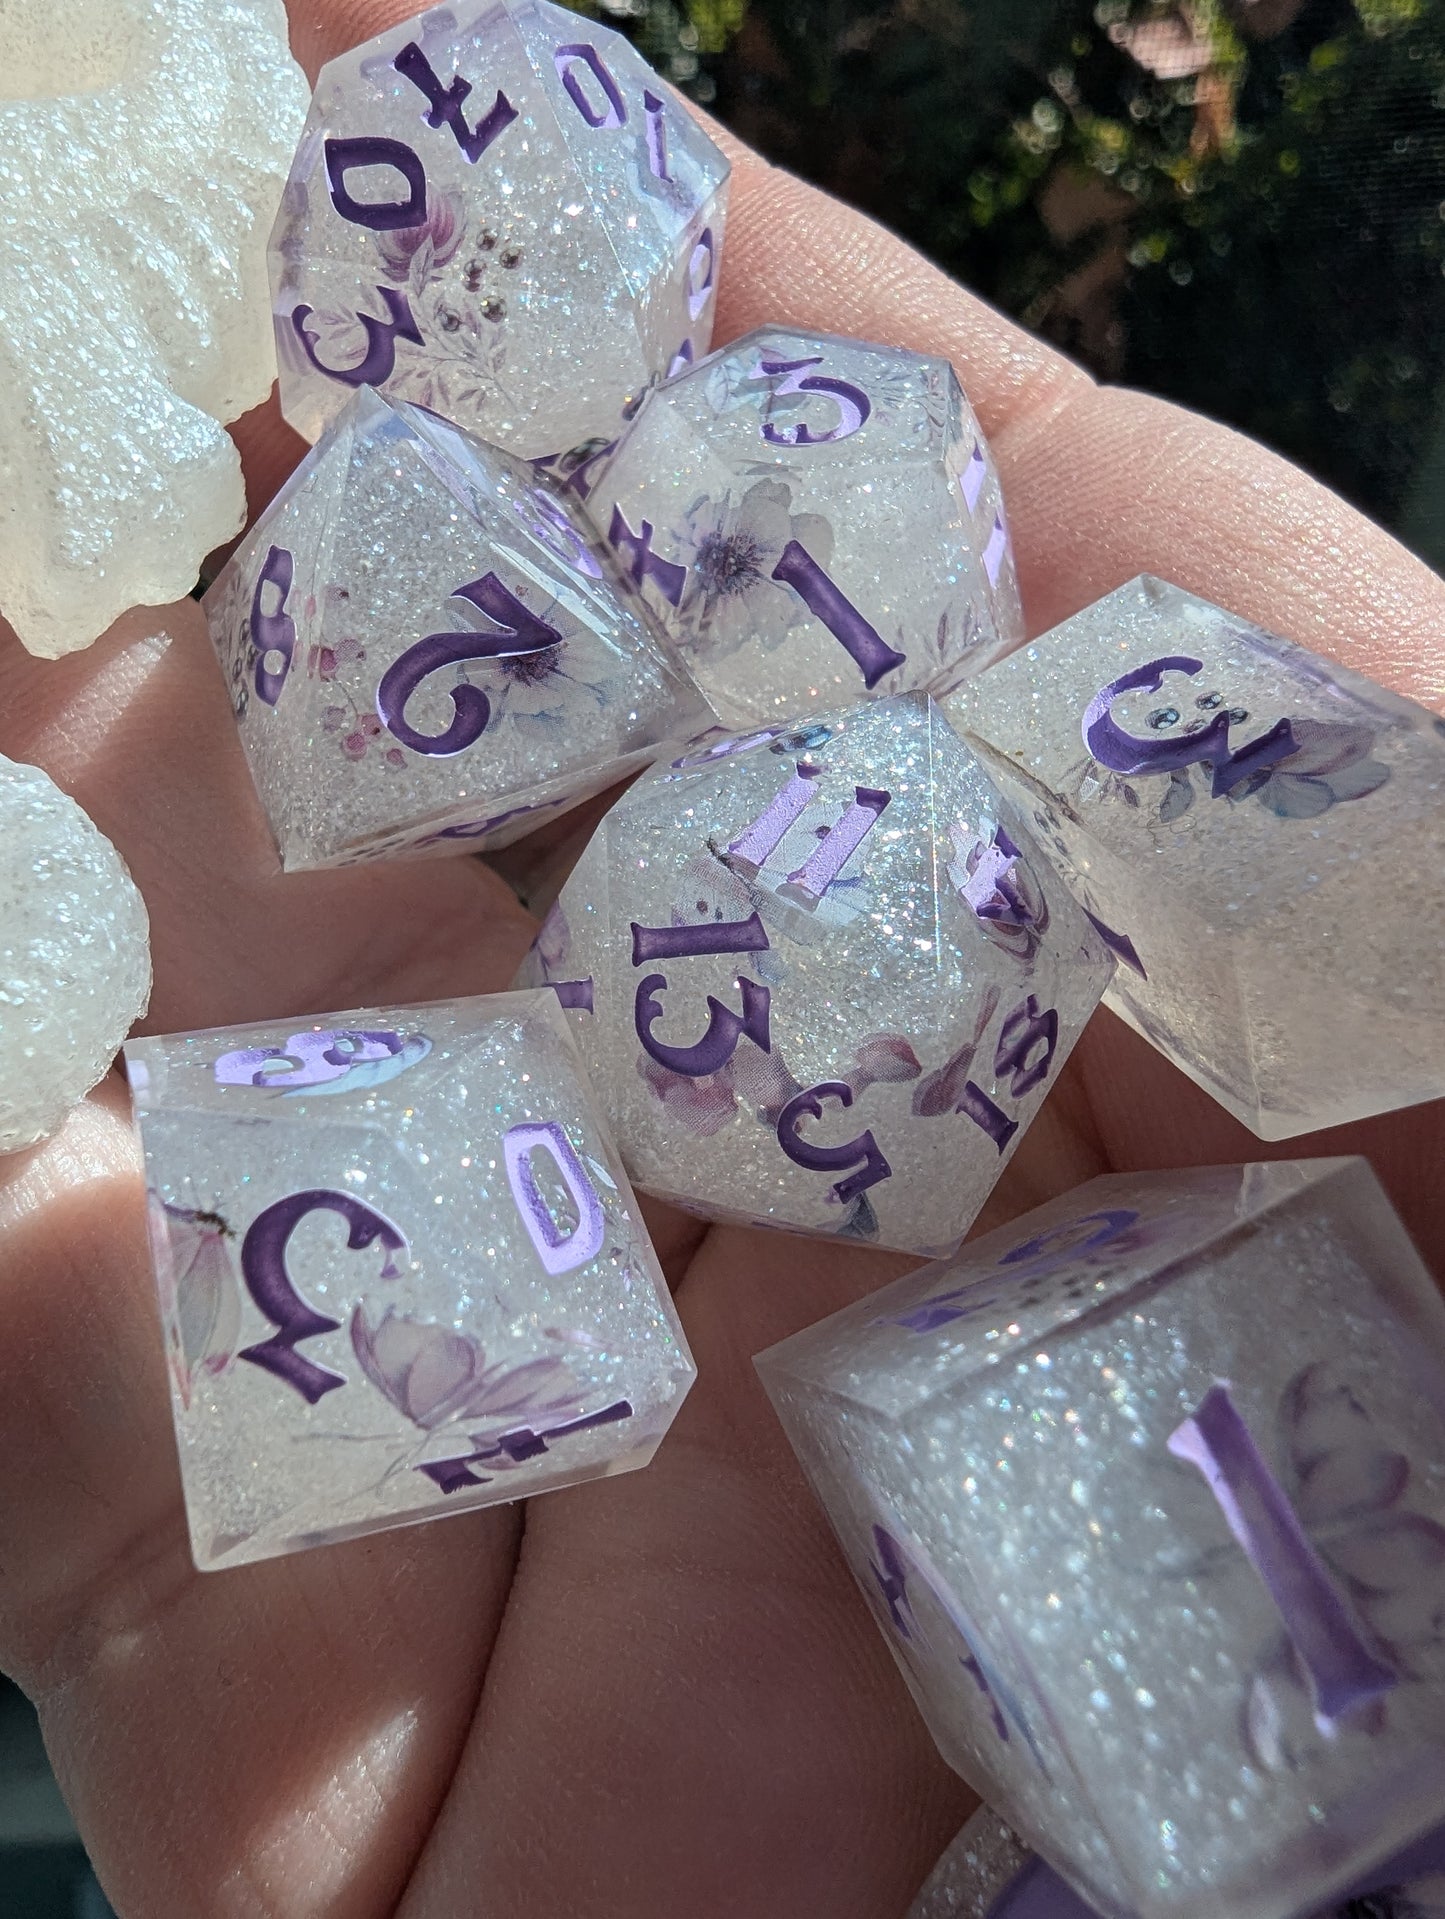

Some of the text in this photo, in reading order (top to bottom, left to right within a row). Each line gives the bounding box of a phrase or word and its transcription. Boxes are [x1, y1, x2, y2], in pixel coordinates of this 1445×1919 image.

[325, 42, 519, 231] 70
[376, 571, 563, 758] 2
[771, 540, 907, 690] 1
[1081, 655, 1302, 799] 3
[727, 761, 892, 898] 11
[631, 912, 771, 1077] 13
[776, 1080, 893, 1204] 5
[238, 1187, 411, 1405] 3
[1168, 1376, 1402, 1740] 1
